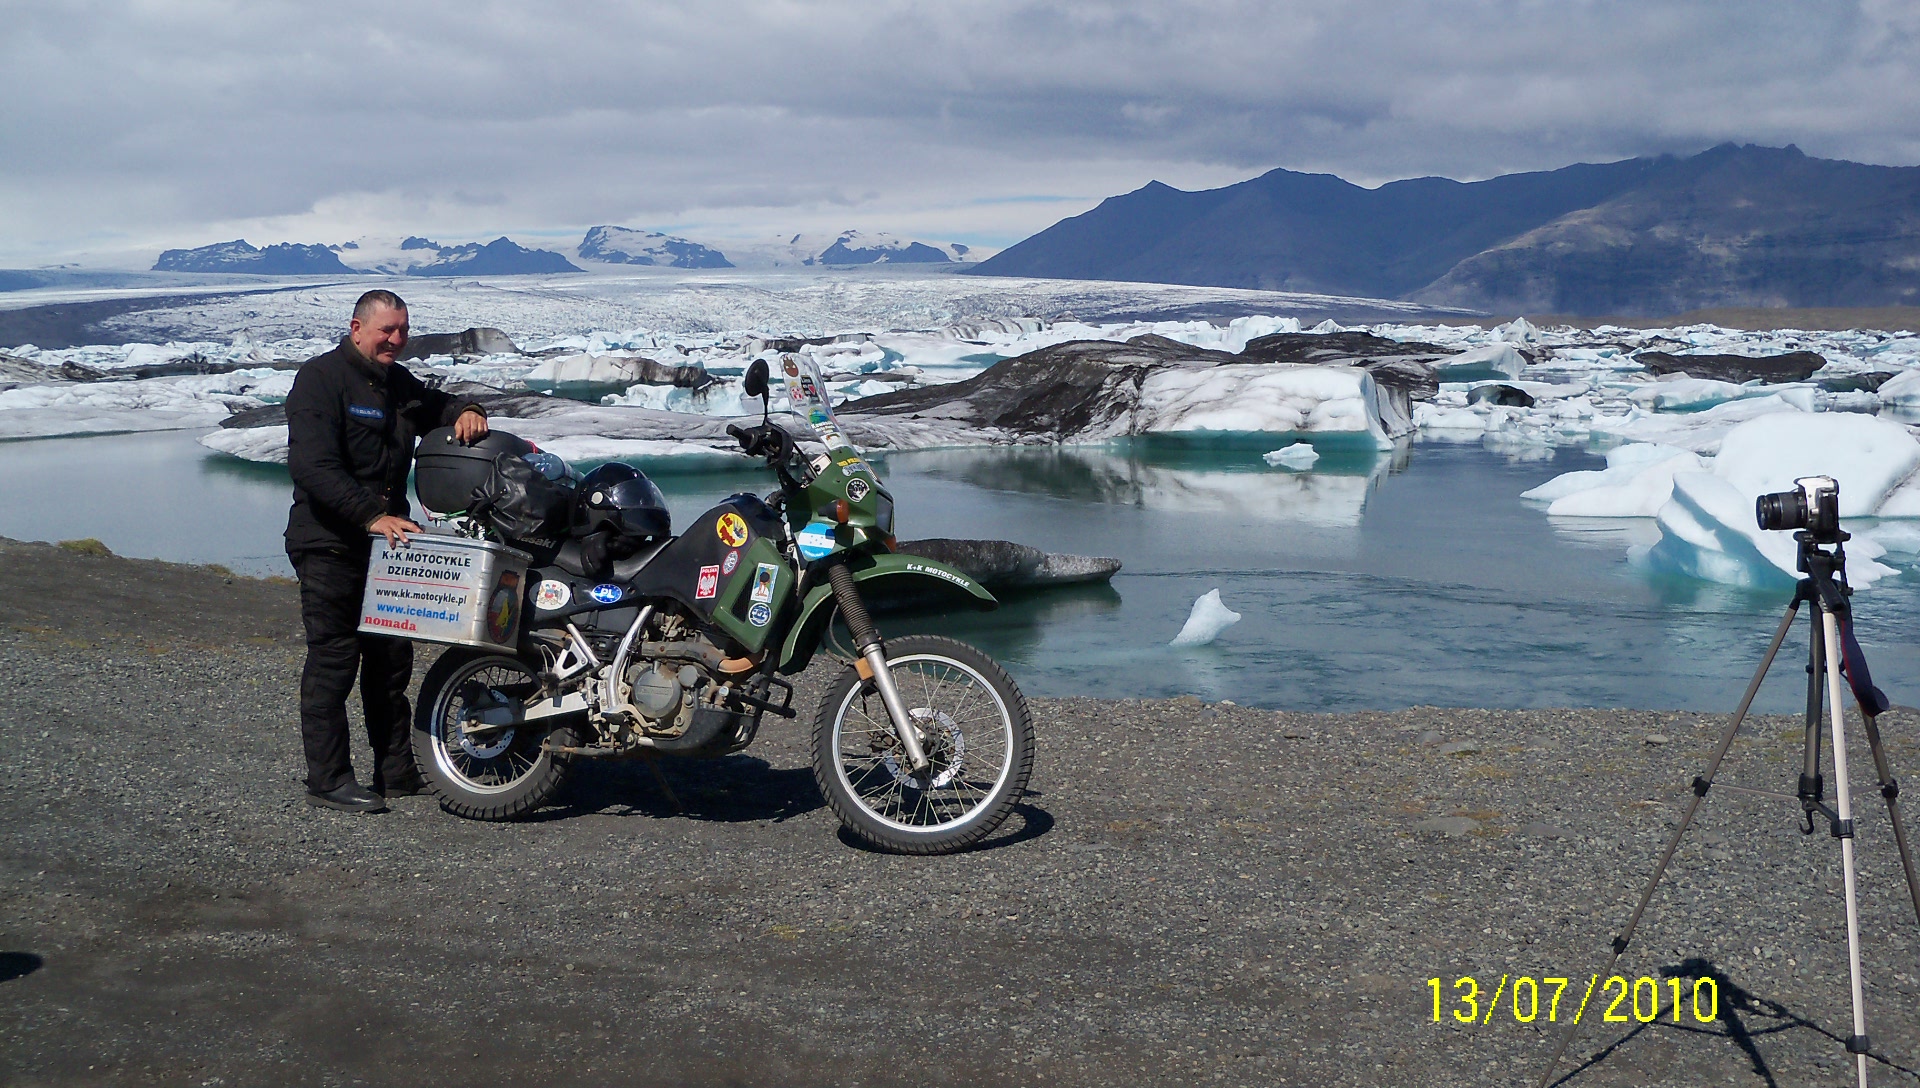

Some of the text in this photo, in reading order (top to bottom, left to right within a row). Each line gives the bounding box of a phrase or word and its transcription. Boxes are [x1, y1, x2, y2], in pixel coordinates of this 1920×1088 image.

[382, 550, 472, 568] K+K MOTOCYKLE
[387, 565, 461, 581] DZIERŻONIÓW
[906, 563, 971, 588] K+K MOTOCYKLE
[376, 588, 467, 607] www.kk.motocykle.pl
[600, 587, 615, 599] PL
[377, 602, 460, 623] www.iceland.pl
[364, 615, 417, 632] nomada
